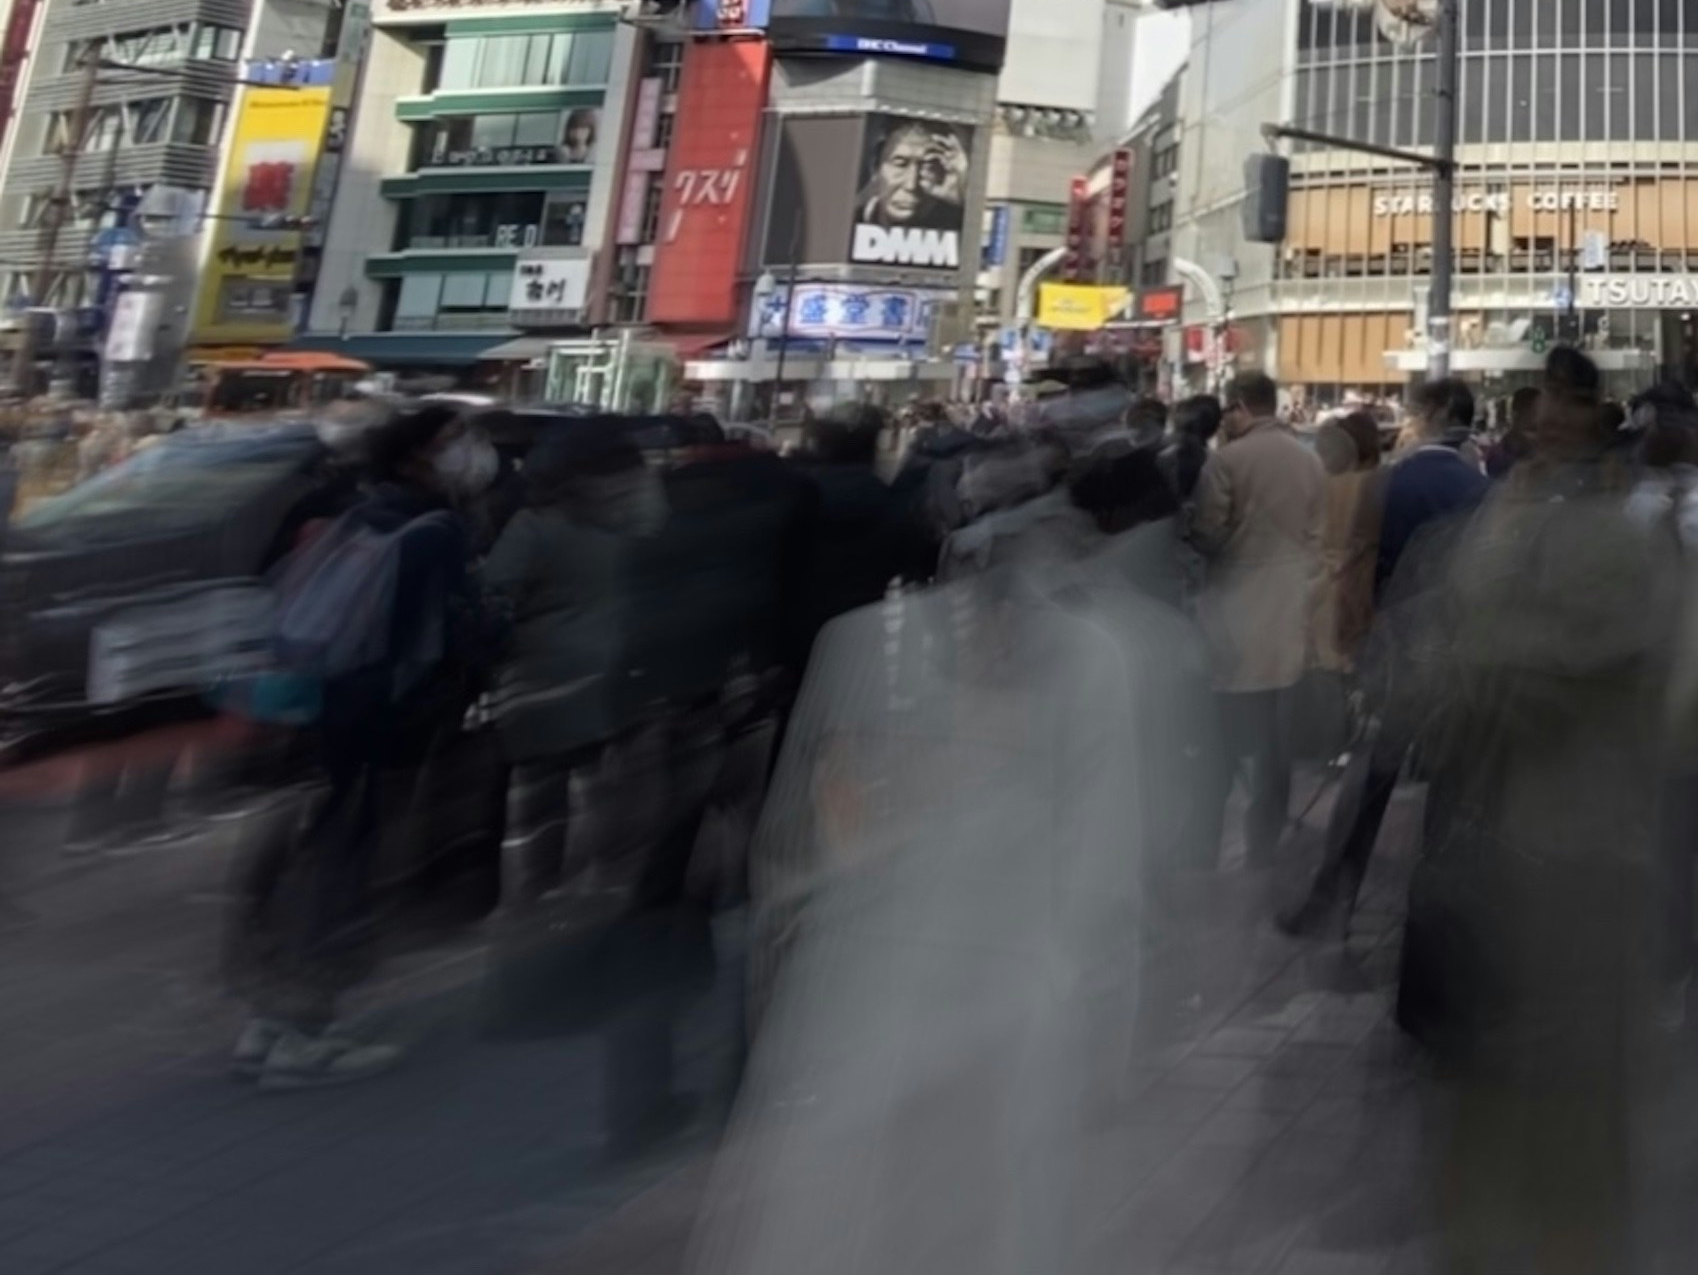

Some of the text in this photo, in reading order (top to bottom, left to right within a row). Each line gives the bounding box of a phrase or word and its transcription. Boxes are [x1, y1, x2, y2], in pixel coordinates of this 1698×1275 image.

[674, 162, 738, 206] クスリ
[1373, 190, 1620, 216] STARUCKS COFFEE
[851, 223, 960, 269] DMM
